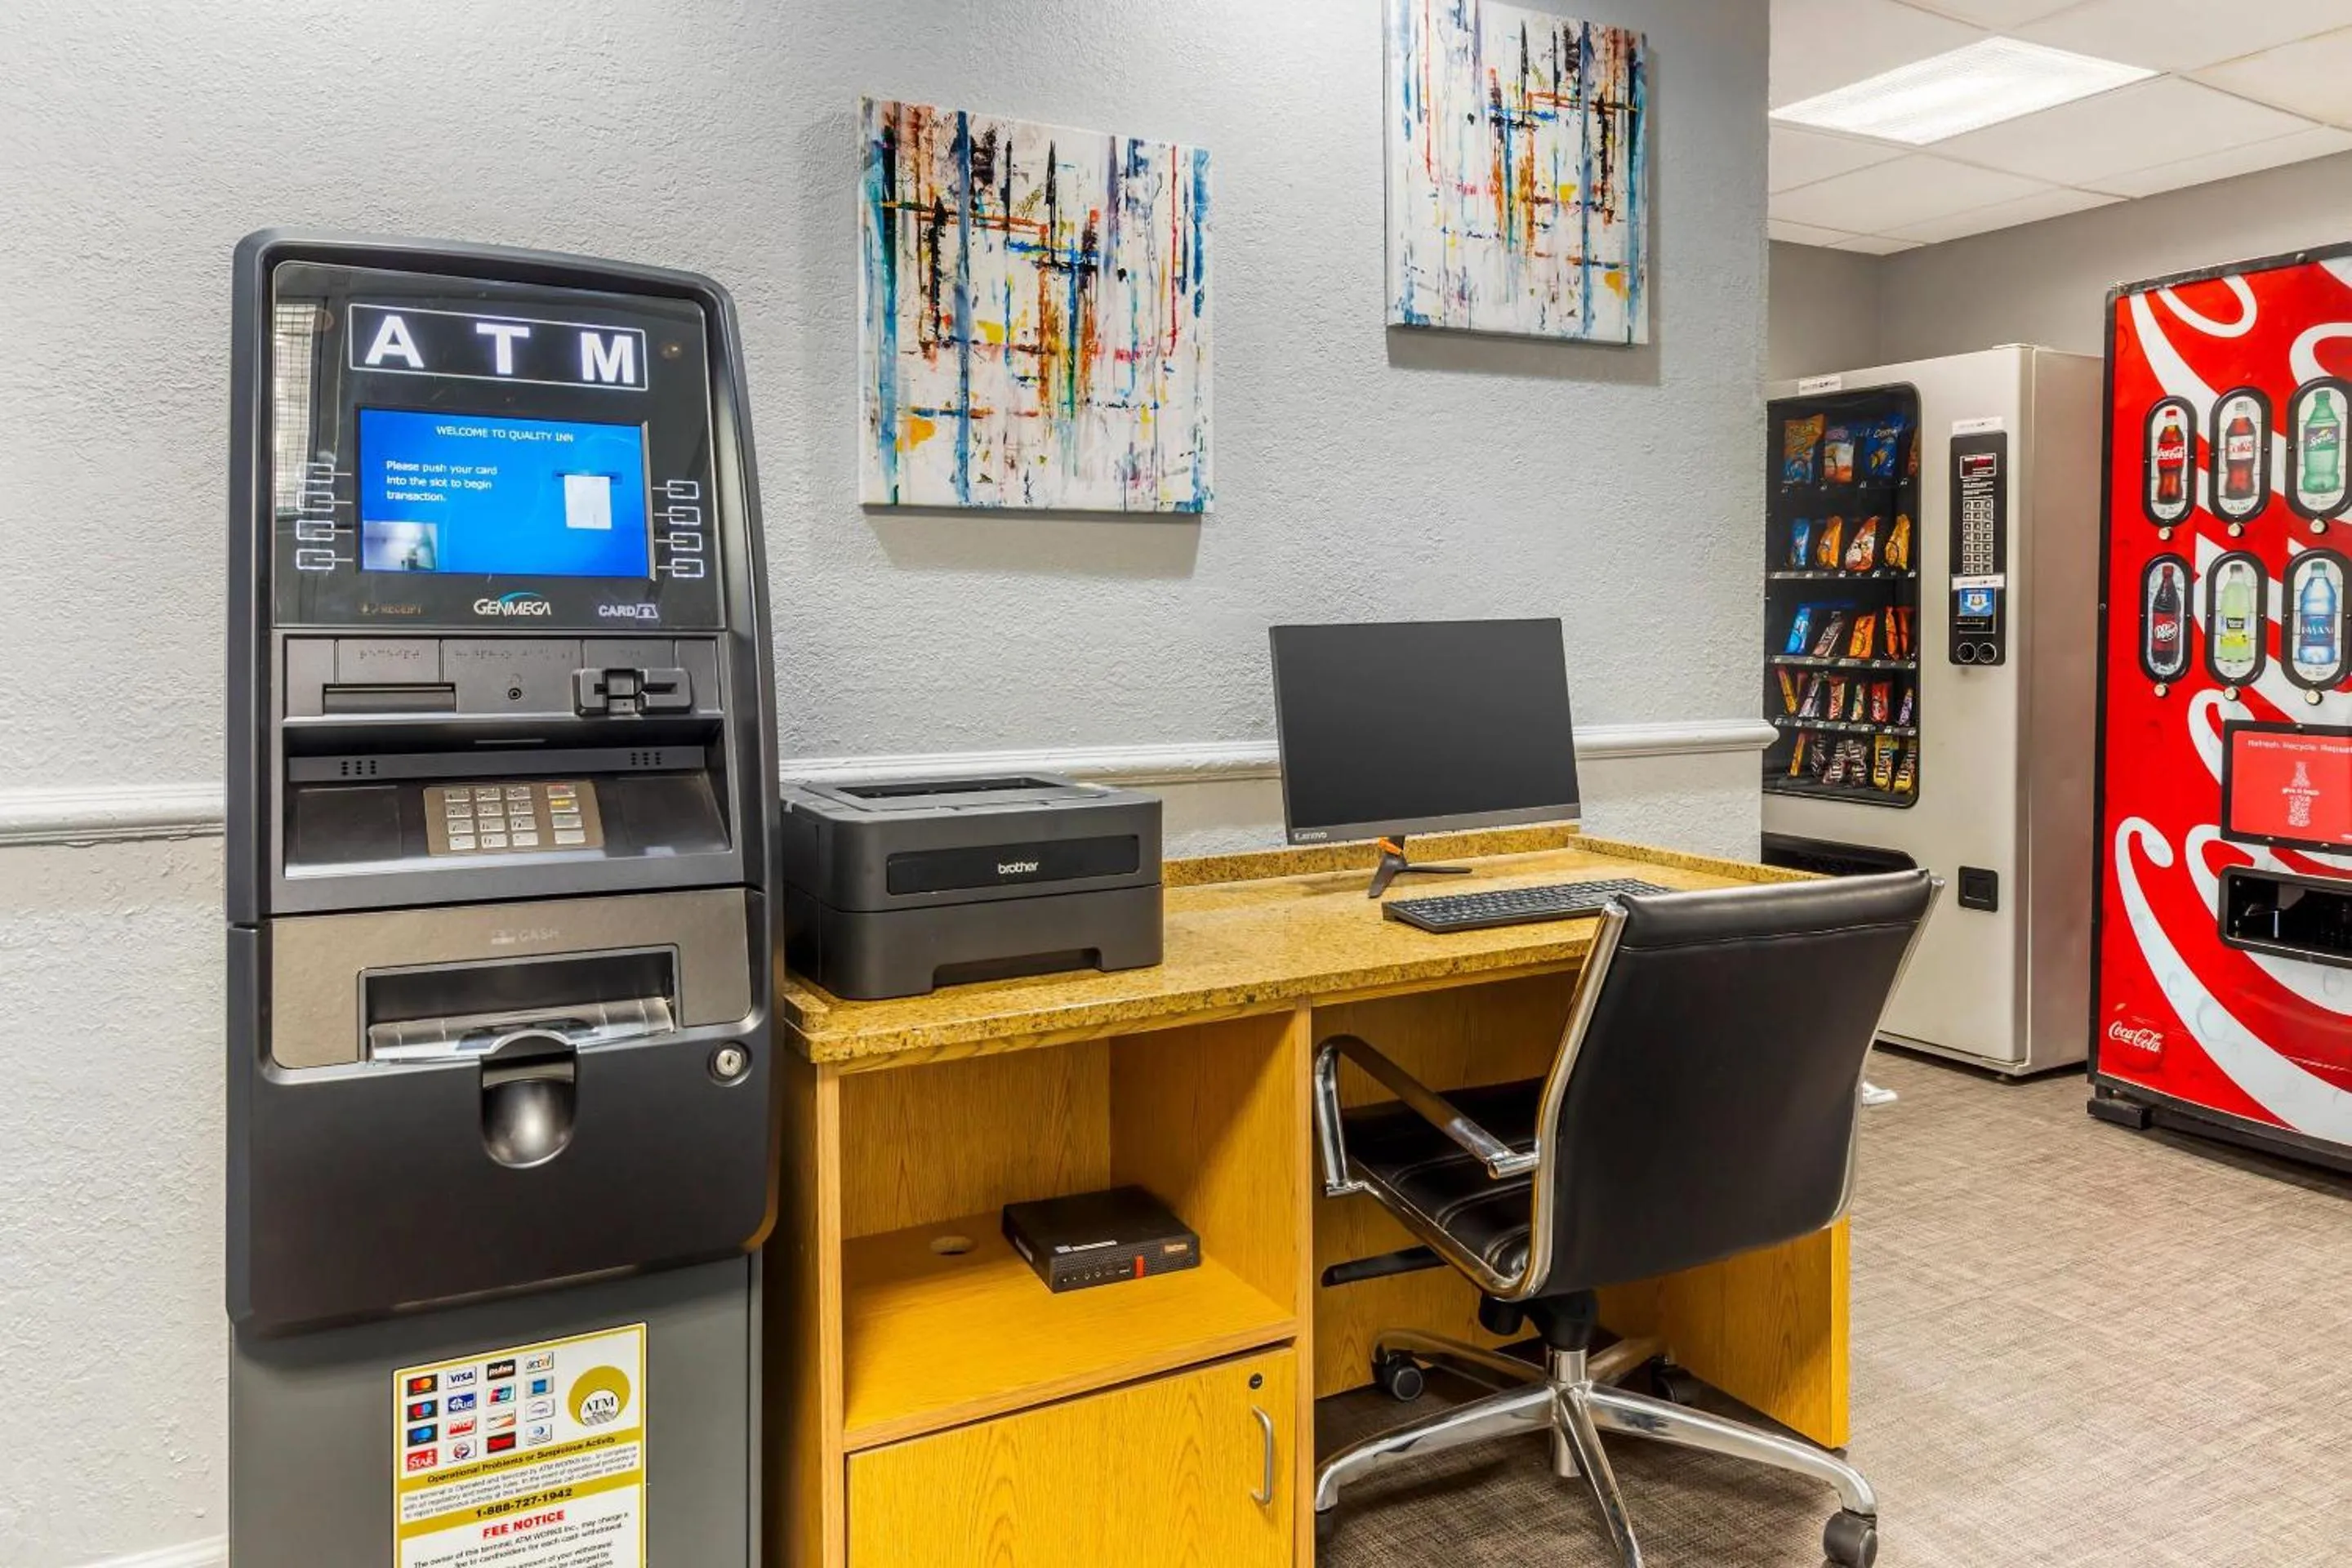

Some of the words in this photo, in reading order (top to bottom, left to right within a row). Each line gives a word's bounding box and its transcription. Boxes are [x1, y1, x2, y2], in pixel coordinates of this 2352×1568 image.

[436, 425, 488, 438] WELCOME
[492, 429, 506, 438] TO
[509, 430, 552, 441] QUALITY
[555, 432, 573, 443] INN
[386, 460, 419, 471] Please
[422, 464, 447, 473] push
[450, 465, 474, 474] your
[474, 466, 498, 475] card
[409, 476, 427, 487] the
[429, 478, 448, 488] slot
[451, 479, 462, 488] to
[463, 479, 492, 490] begin
[386, 490, 446, 501] transaction.
[474, 598, 551, 617] GENMEGA
[599, 604, 635, 617] CARD
[1294, 831, 1327, 841] Lenovo
[998, 861, 1039, 875] brother
[518, 929, 559, 940] CASH
[2108, 1020, 2164, 1054] Coca-Cola
[450, 1371, 474, 1383] VISA
[583, 1396, 614, 1414] ATM
[408, 1457, 434, 1470] STAR
[427, 1467, 478, 1484] Operational
[482, 1458, 523, 1471] Problems
[586, 1437, 616, 1448] Activity
[476, 1488, 572, 1517] 1-888-727-1942
[483, 1523, 510, 1538] FEE
[513, 1509, 565, 1531] NOTICE
[515, 1535, 532, 1544] ATM
